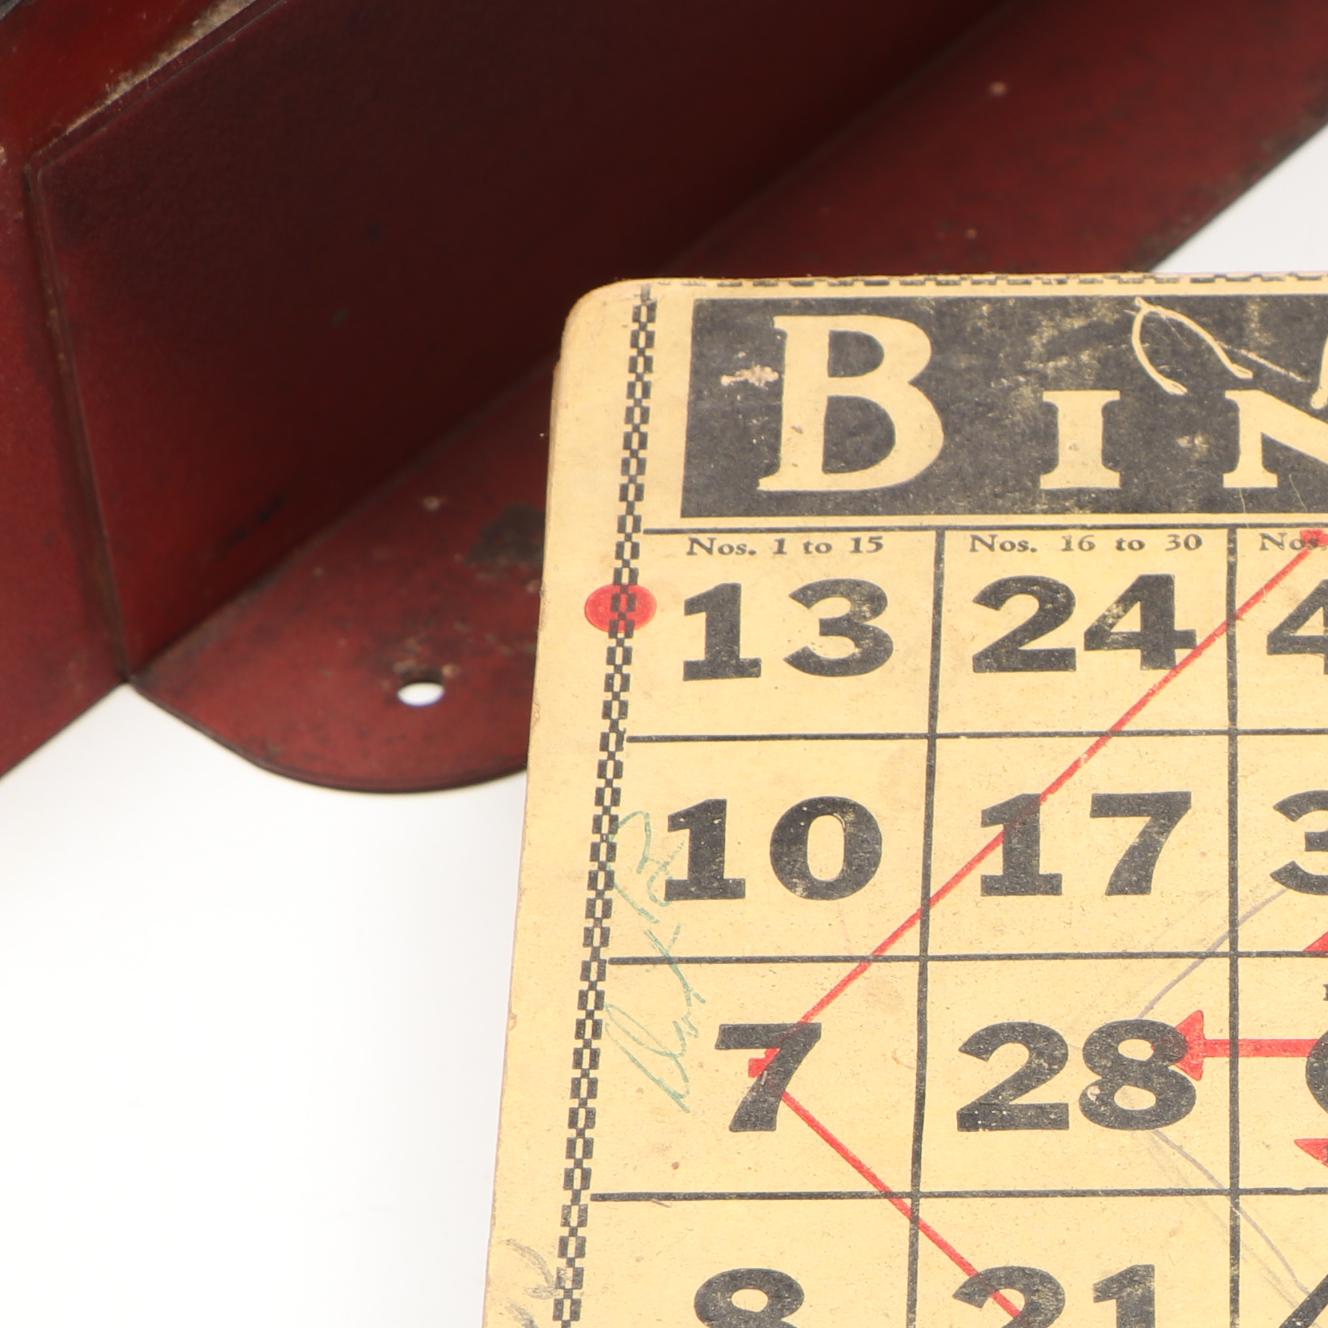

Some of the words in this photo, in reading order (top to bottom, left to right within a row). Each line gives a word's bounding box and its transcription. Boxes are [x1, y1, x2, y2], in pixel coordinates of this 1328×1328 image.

[686, 535, 758, 556] Nos.
[772, 536, 788, 555] 1
[802, 536, 833, 555] to
[850, 535, 884, 554] 15
[969, 534, 1038, 554] Nos.
[1061, 534, 1096, 552] 16
[1115, 537, 1146, 552] to
[1165, 533, 1203, 552] 30
[682, 578, 894, 682] 13
[972, 573, 1197, 674] 24
[663, 796, 883, 903] 10
[980, 790, 1192, 897] 17
[714, 1021, 822, 1133] 7
[956, 1018, 1197, 1133] 28
